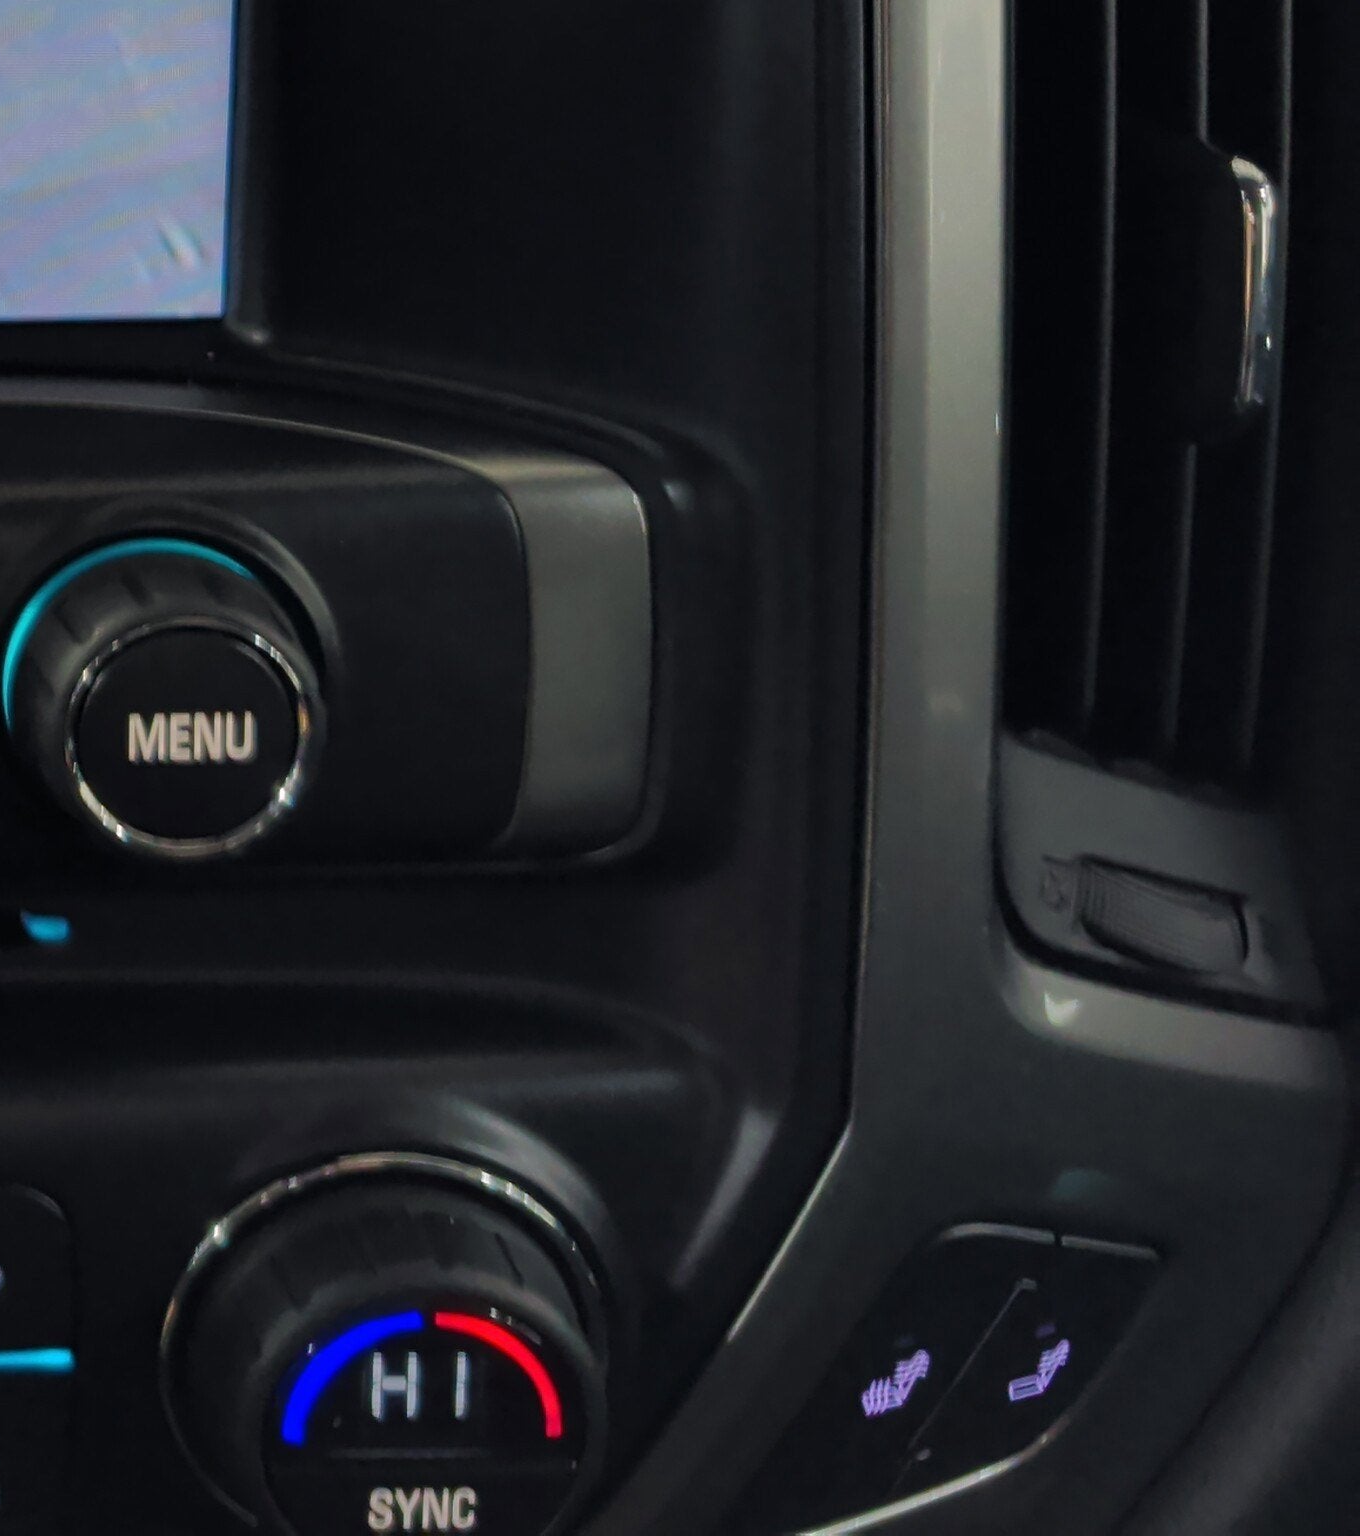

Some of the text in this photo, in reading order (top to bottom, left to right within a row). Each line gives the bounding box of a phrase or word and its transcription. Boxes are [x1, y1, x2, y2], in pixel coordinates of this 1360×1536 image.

[127, 710, 257, 763] MENU
[370, 1351, 470, 1421] HI
[367, 1486, 477, 1532] SYNC
